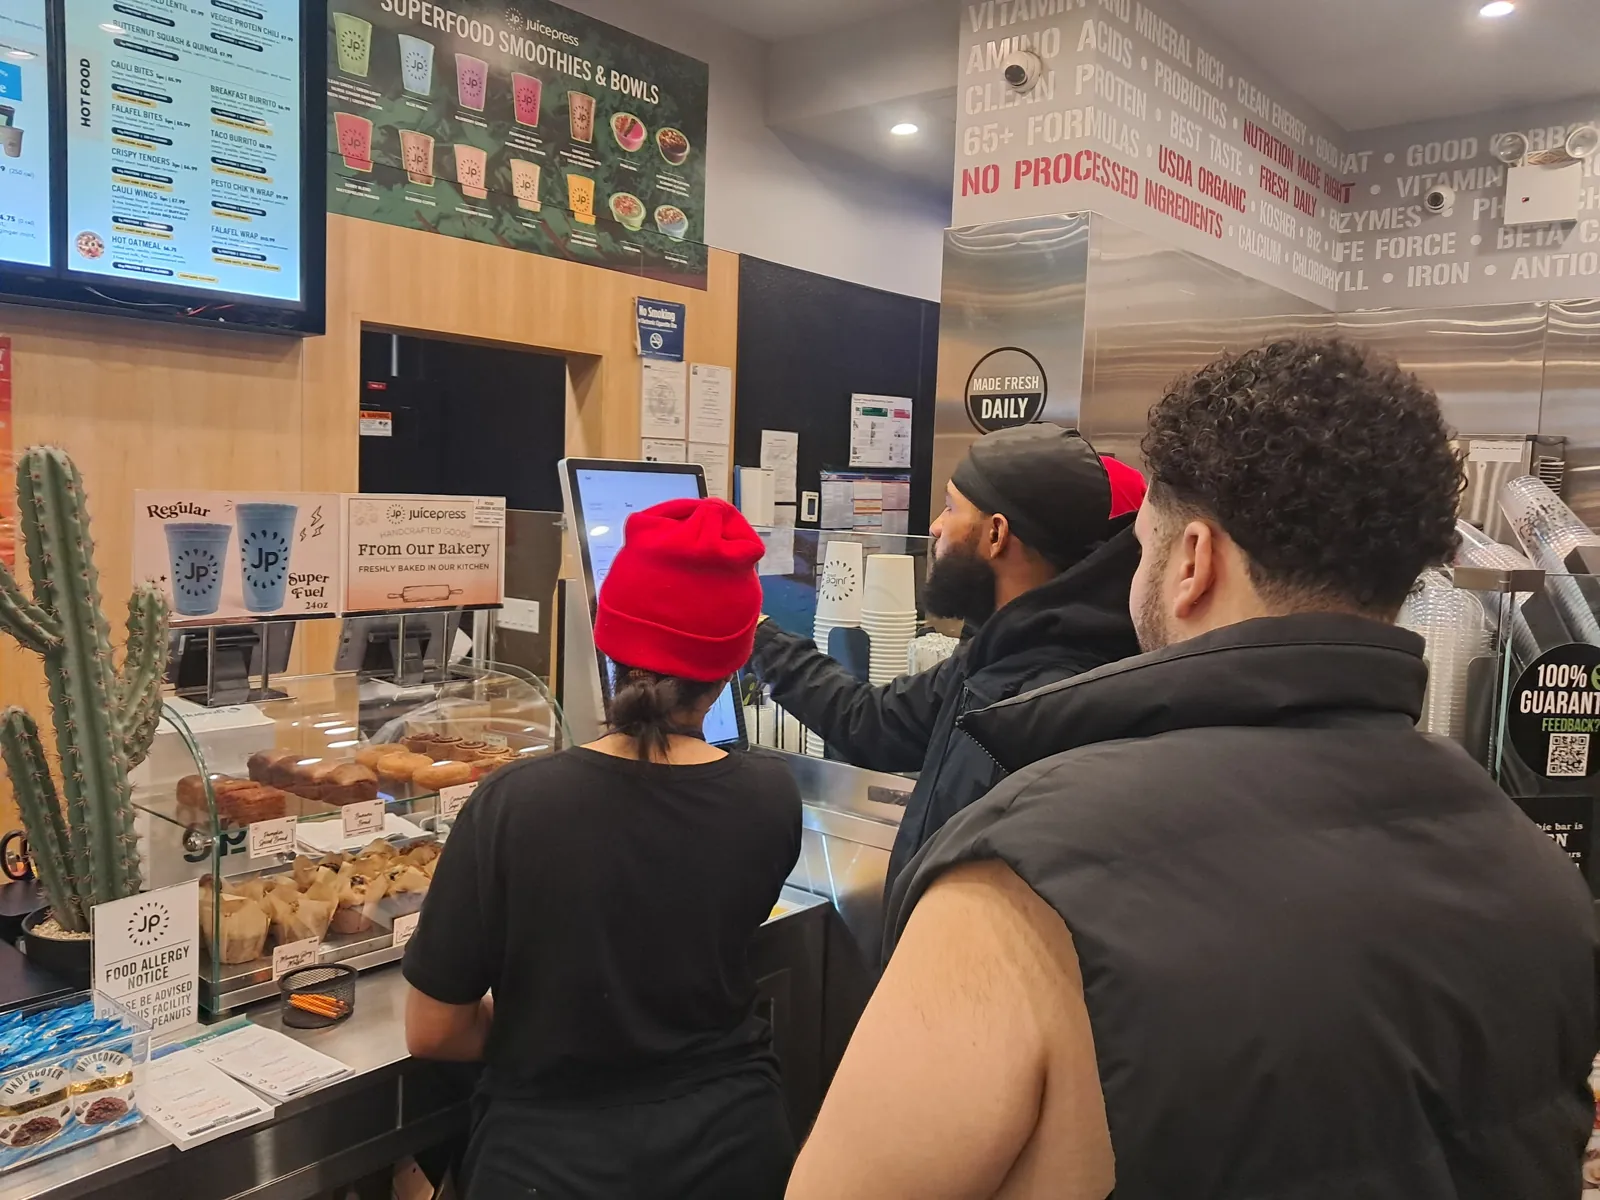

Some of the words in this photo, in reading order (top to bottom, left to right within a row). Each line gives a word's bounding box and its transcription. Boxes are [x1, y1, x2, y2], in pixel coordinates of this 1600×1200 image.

[210, 11, 234, 24] VEGGIE
[234, 19, 262, 32] PROTEIN
[263, 27, 280, 38] CHILI
[526, 19, 580, 47] juicepress
[112, 20, 155, 38] BUTTERNUT
[156, 32, 185, 46] SQUASH
[192, 41, 218, 55] QUINOA
[380, 0, 495, 47] SUPERFOOD
[499, 30, 592, 82] SMOOTHIES
[595, 65, 607, 87] &
[610, 69, 660, 105] BOWLS
[80, 58, 91, 98] FOOD
[111, 60, 133, 72] CAULI
[134, 65, 154, 77] BITES
[210, 84, 248, 101] BREAKFAST
[248, 94, 277, 108] BURRITO
[1135, 2, 1193, 69] MINERAL
[1196, 47, 1224, 90] RICH
[1237, 77, 1270, 122] CLEAN
[1271, 101, 1307, 147] ENERGY
[1316, 133, 1339, 168] GOOD
[1338, 150, 1373, 175] FAT
[1406, 137, 1478, 167] GOOD
[80, 102, 91, 127] HOT
[111, 104, 141, 117] FALAFEL
[143, 111, 163, 121] BITES
[1076, 18, 1133, 69] ACIDS
[1154, 58, 1228, 130] PROBIOTICS
[1243, 118, 1294, 172] NUTRITION
[1297, 154, 1321, 189] MADE
[1323, 172, 1356, 204] RIGHT
[211, 129, 228, 140] TACO
[229, 133, 257, 147] BURRITO
[1075, 63, 1147, 121] PROTEIN
[1170, 109, 1203, 152] BEST
[1209, 133, 1243, 176] TASTE
[1259, 164, 1290, 203] FRESH
[1293, 185, 1317, 218] DAILY
[1329, 204, 1422, 234] ENZYMES
[111, 147, 137, 160] CRISPY
[139, 152, 170, 166] TENDERS
[111, 184, 132, 196] CAULI
[134, 187, 158, 200] WINGS
[210, 178, 232, 189] PESTO
[256, 187, 275, 198] WRAP
[963, 122, 1014, 156] 65+
[1027, 105, 1140, 158] FORMULAS
[1158, 144, 1193, 187] USDA
[1198, 166, 1247, 214] ORGANIC
[1259, 200, 1296, 240] KOSHER
[1306, 227, 1322, 253] B12
[1375, 232, 1456, 260] FORCE
[1496, 224, 1565, 250] BETA
[961, 164, 1000, 197] NO
[1014, 149, 1139, 200] PROCESSED
[1144, 177, 1223, 239] INGREDIENTS
[1238, 224, 1282, 265] CALCIUM
[1292, 251, 1369, 292] CHLOROPHYLL
[1407, 261, 1470, 287] IRON
[1510, 251, 1600, 281] ANTIO
[111, 236, 126, 245] HOT
[128, 238, 162, 250] OATMEAL
[211, 225, 239, 237] FALAFEL
[240, 230, 259, 239] WRAP
[973, 377, 1001, 391] MADE
[1004, 375, 1039, 390] FRESH
[981, 397, 1029, 419] DAILY
[147, 501, 211, 519] Regular
[408, 507, 467, 521] juicepress
[380, 527, 442, 539] HANDCRAFTED
[444, 527, 472, 539] GOODS
[358, 543, 405, 556] From
[406, 543, 435, 556] Our
[438, 542, 491, 557] Bakery
[288, 572, 330, 586] Super
[358, 565, 396, 573] FRESHLY
[398, 564, 426, 572] BAKED
[439, 563, 455, 571] OUR
[457, 563, 490, 571] KITCHEN
[291, 586, 325, 599] Fuel
[305, 601, 329, 610] 24oz
[1537, 663, 1588, 689] 100%
[1520, 690, 1600, 715] GUARANT
[1541, 717, 1600, 733] FEEDBACK?
[1554, 822, 1572, 831] bar
[1574, 822, 1584, 830] is
[106, 962, 137, 983] FOOD
[141, 945, 190, 972] ALLERGY
[127, 965, 169, 990] NOTICE
[140, 994, 152, 1007] BE
[154, 980, 193, 1003] ADVISED
[152, 993, 191, 1016] FACILITY
[152, 1005, 192, 1030] PEANUTS
[76, 1051, 124, 1072] UNDERCOVER
[4, 1067, 64, 1095] UNDERCOVER
